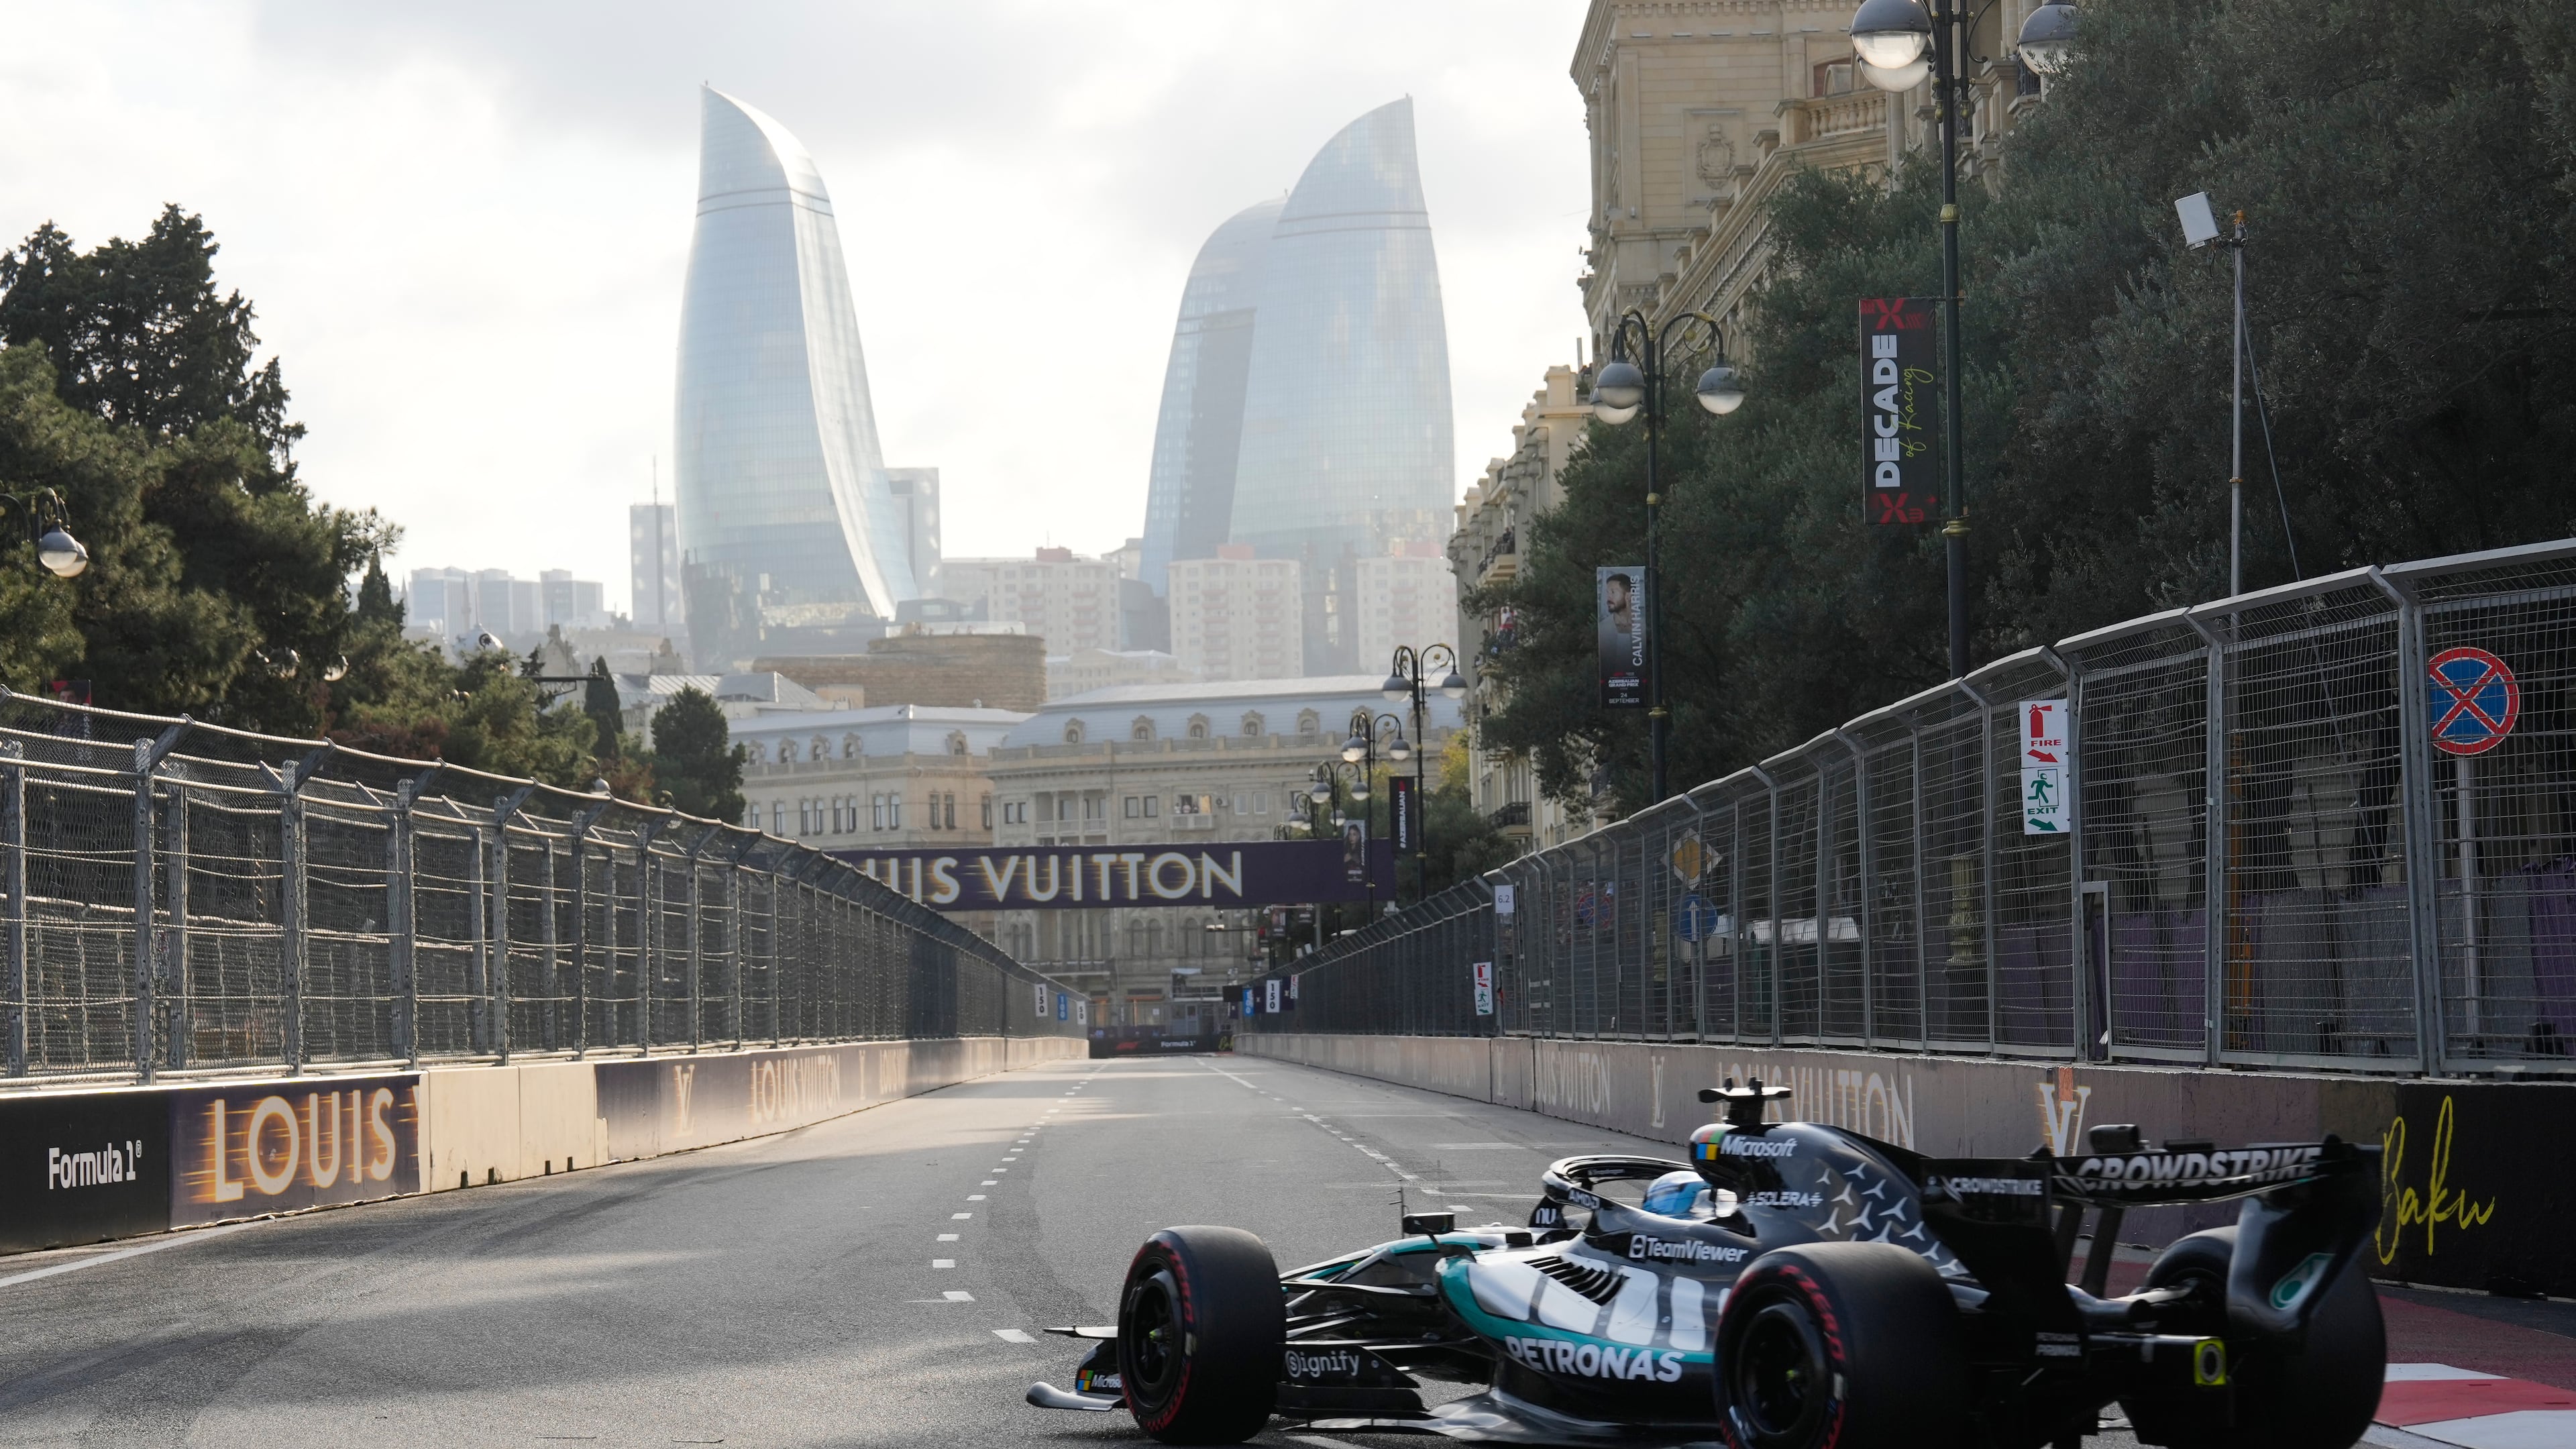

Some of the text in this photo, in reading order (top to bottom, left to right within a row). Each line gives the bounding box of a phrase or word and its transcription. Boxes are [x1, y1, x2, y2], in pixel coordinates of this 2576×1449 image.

[1872, 335, 1900, 488] DECADE
[1890, 364, 1934, 458] of Racing
[1630, 575, 1643, 666] CALVIN HARRIS
[980, 851, 1242, 902] VUITTON
[1498, 895, 1510, 903] 6.2
[750, 1060, 800, 1124] LOUIS
[800, 1053, 841, 1112] VUITTON
[1558, 1051, 1611, 1114] VUITTON
[1790, 1065, 1915, 1151] VUITTON
[48, 1146, 123, 1190] Formula
[214, 1087, 396, 1203] LOUIS
[1720, 1135, 1798, 1157] Microsoft
[2078, 1146, 2323, 1192] CROWDSTRIKE
[1568, 1189, 1593, 1207] AMD
[1754, 1191, 1809, 1206] SOLERA
[1950, 1177, 2043, 1195] CROWDSTRIKE
[2374, 1095, 2496, 1265] Baku
[1646, 1237, 1749, 1263] TeamViewer
[1285, 1350, 1359, 1378] signify
[1504, 1335, 1686, 1383] PETRONAS
